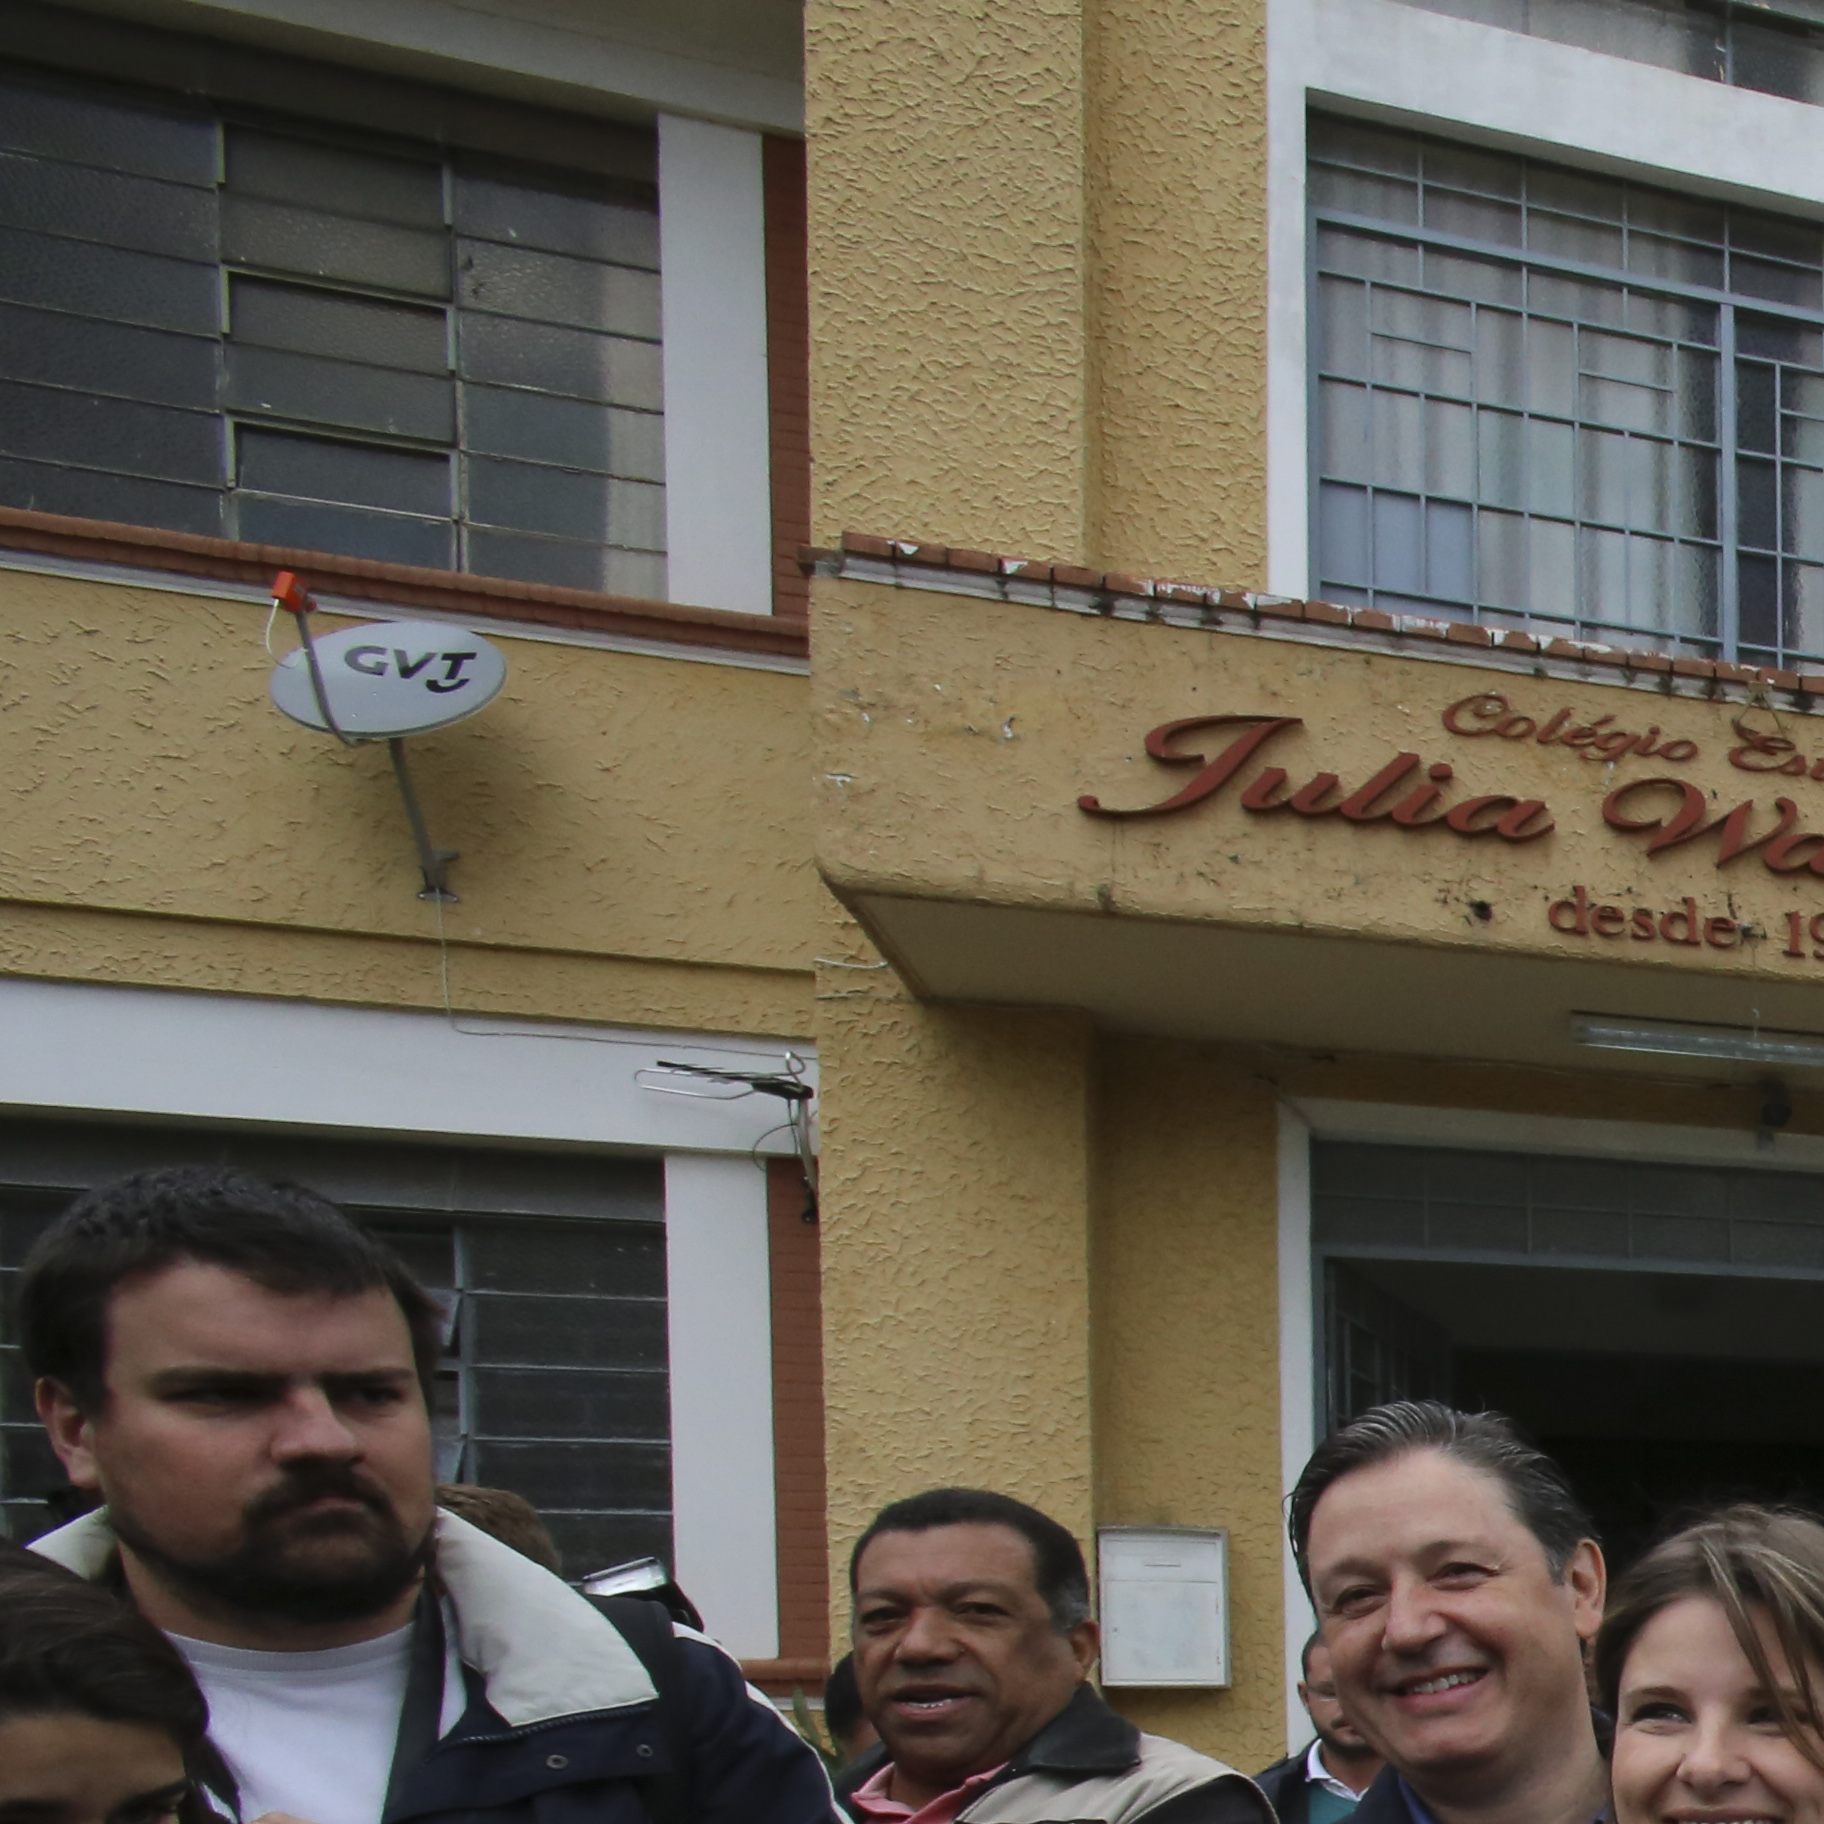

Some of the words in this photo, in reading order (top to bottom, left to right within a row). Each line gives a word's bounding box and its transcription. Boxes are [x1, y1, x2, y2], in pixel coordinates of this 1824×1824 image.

[344, 645, 477, 693] GVT
[1442, 694, 1698, 762] Colégio
[1077, 714, 1556, 843] Julia
[1547, 885, 1738, 949] desde
